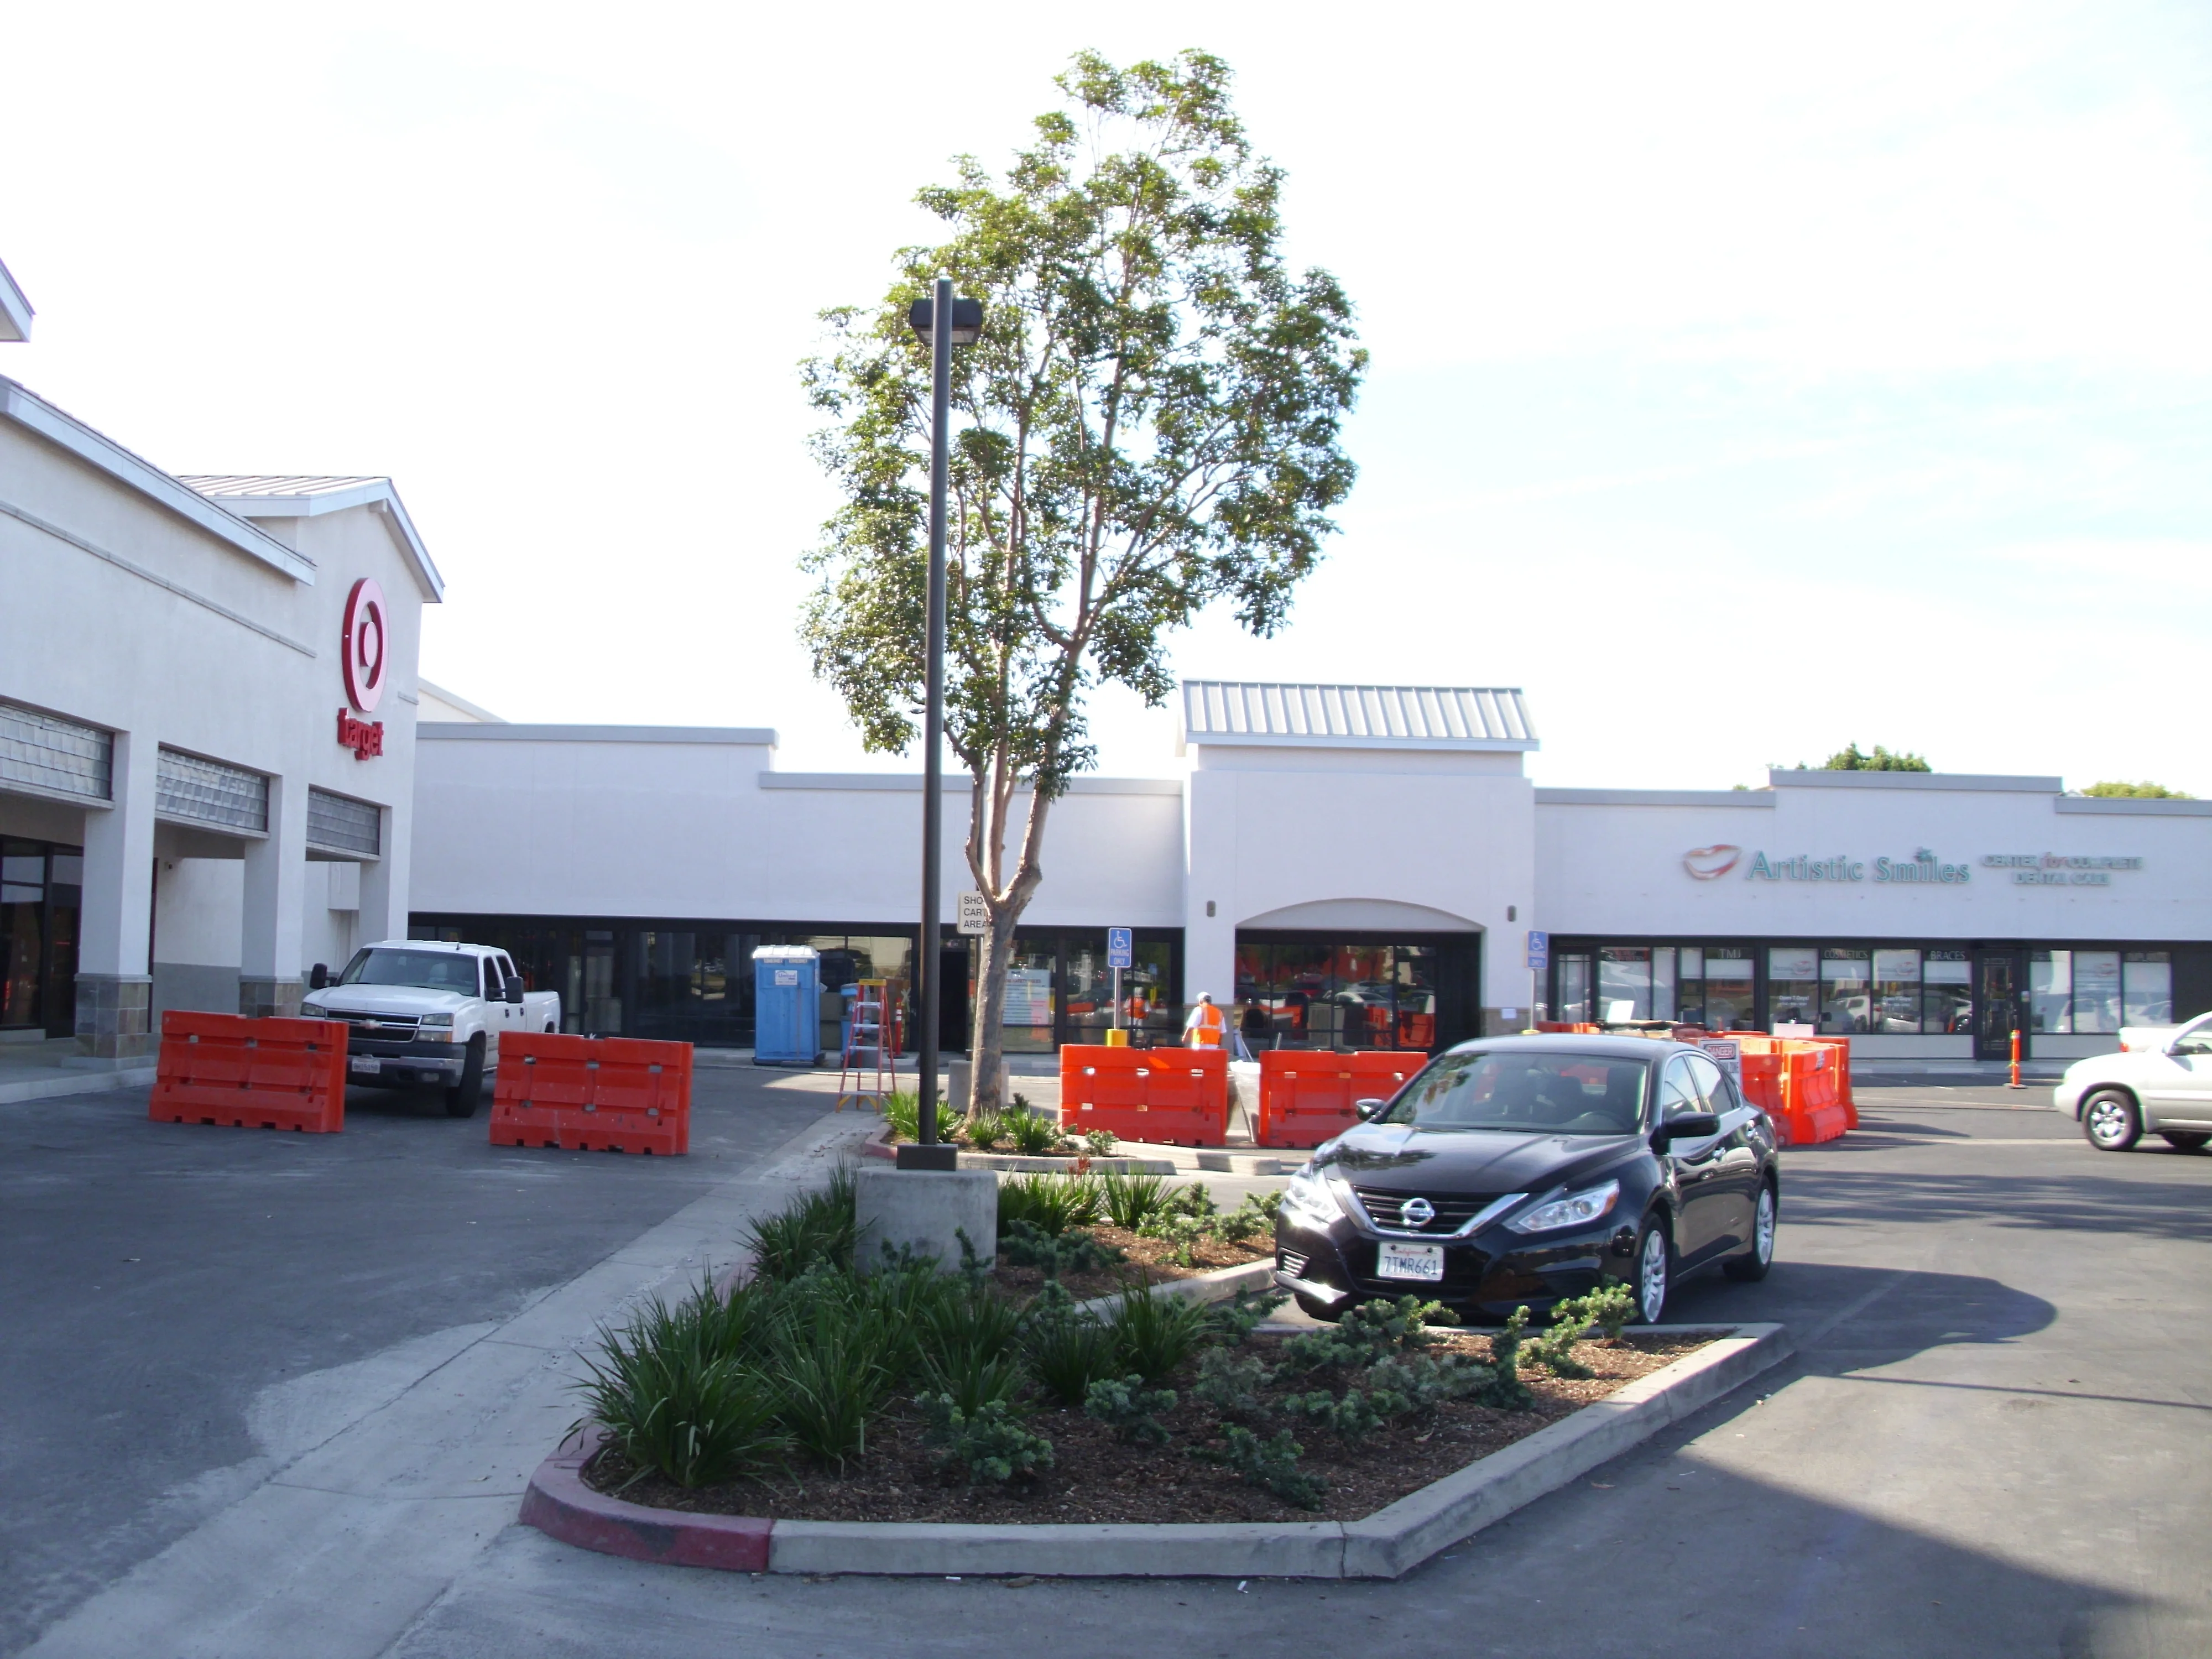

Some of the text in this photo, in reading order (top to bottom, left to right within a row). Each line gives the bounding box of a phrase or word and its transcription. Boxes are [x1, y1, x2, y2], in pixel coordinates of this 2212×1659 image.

[337, 707, 384, 761] target
[1747, 851, 1970, 883] Artistic Smiles
[1981, 854, 2039, 868] CENTER
[2067, 857, 2143, 869] COMPLETE
[2013, 872, 2110, 886] DENTAL CARE
[964, 896, 984, 904] SHO
[1719, 948, 1741, 959] TMJ
[1824, 950, 1868, 959] COSMETICS
[1930, 951, 1965, 960] BRACES
[1707, 1046, 1733, 1057] DANGER
[1384, 1256, 1438, 1275] 7TMR661
